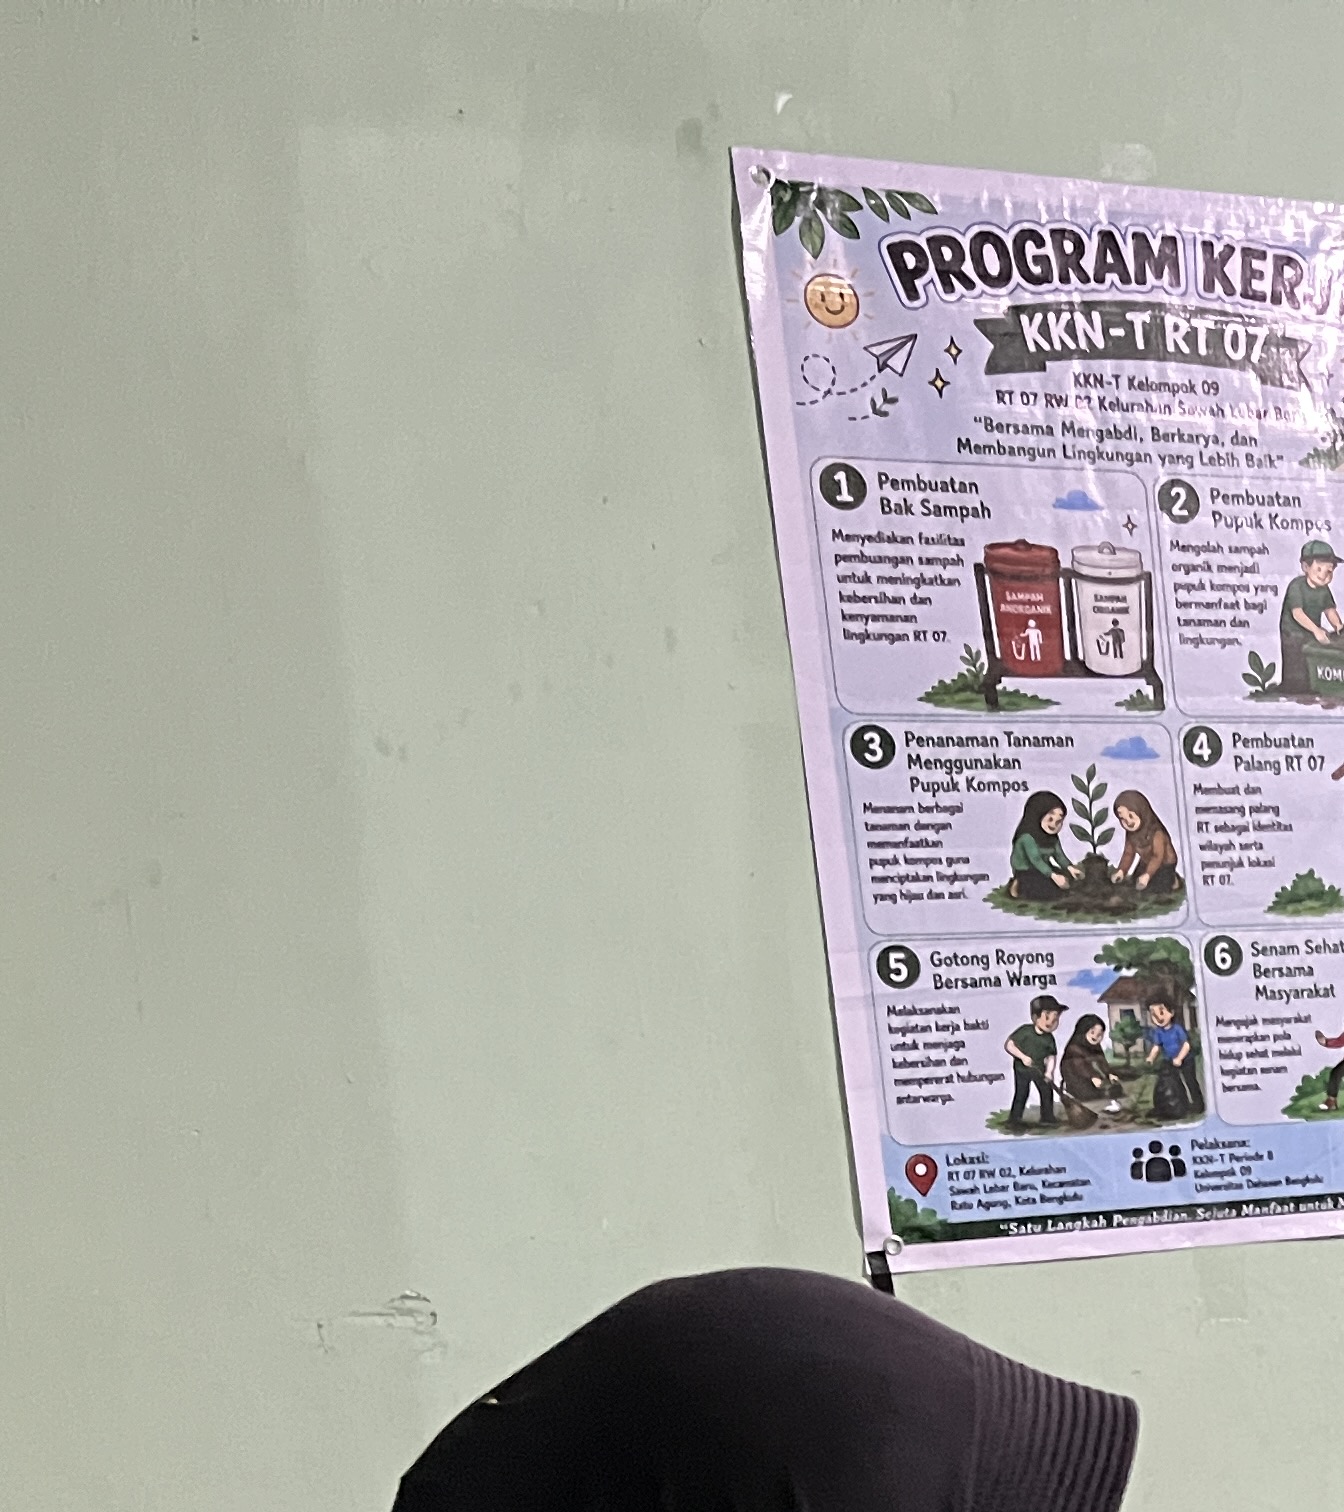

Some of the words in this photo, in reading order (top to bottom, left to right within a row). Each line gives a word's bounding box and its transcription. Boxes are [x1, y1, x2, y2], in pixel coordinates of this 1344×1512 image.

[886, 228, 1182, 303] PROGRAM
[1020, 310, 1151, 354] KKN-T
[1164, 313, 1215, 356] RT
[1223, 323, 1270, 364] 07
[1072, 372, 1121, 390] KKN-T
[1127, 375, 1198, 397] Kelompok
[1202, 380, 1220, 396] 09
[996, 389, 1014, 406] RT
[1020, 392, 1038, 406] 07
[1044, 393, 1069, 409] RW
[1151, 426, 1225, 448] Berkarya,
[1230, 430, 1258, 447] dan
[957, 437, 1056, 462] Membangun
[1063, 443, 1152, 467] Lingkungan
[1158, 453, 1194, 469] yang
[1199, 451, 1240, 468] Lebih
[833, 470, 854, 502] 1
[877, 472, 979, 495] Pembuatan
[1170, 486, 1189, 516] 2
[1210, 487, 1302, 507] Pembuatan
[880, 497, 915, 516] Bak
[920, 498, 991, 523] Sampah
[1212, 510, 1264, 533] Pupuk
[1268, 511, 1332, 536] Kompos
[832, 528, 914, 547] Menyediakan
[834, 550, 914, 569] pembuangan
[918, 554, 965, 569] sampah
[1170, 540, 1224, 557] Mengolah
[1228, 543, 1269, 558] sampah
[836, 571, 872, 584] untuk
[1171, 560, 1213, 575] organik
[910, 592, 932, 605] dan
[841, 609, 918, 626] kenyamanan
[1230, 616, 1250, 628] dan
[843, 628, 909, 645] lingkungan
[914, 630, 928, 642] RT
[863, 731, 883, 763] 3
[904, 731, 999, 748] Penanaman
[1003, 731, 1074, 748] Tanaman
[1193, 732, 1211, 762] 4
[1232, 732, 1314, 749] Pembuatan
[907, 753, 1021, 775] Menggunakan
[1234, 755, 1281, 776] Palang
[1285, 755, 1303, 772] RT
[1307, 755, 1325, 772] 07
[910, 775, 959, 797] Pupuk
[966, 776, 1029, 797] Kompos
[1244, 783, 1262, 796] dan
[1197, 821, 1210, 833] RT
[1214, 941, 1232, 970] 6
[1251, 941, 1300, 957] Senam
[888, 952, 908, 982] 5
[930, 950, 990, 971] Gotong
[995, 949, 1055, 974] Royong
[1253, 963, 1314, 979] Bersama
[933, 972, 1002, 990] Bersama
[1006, 970, 1057, 990] Warga
[1256, 983, 1336, 1005] Masyarakat
[946, 1152, 989, 1167] Lokasi:
[1047, 1215, 1107, 1233] Langkah
[1196, 1207, 1237, 1222] Sejuta
[1241, 1202, 1295, 1216] Manfaat
[1299, 1197, 1335, 1211] untuk
